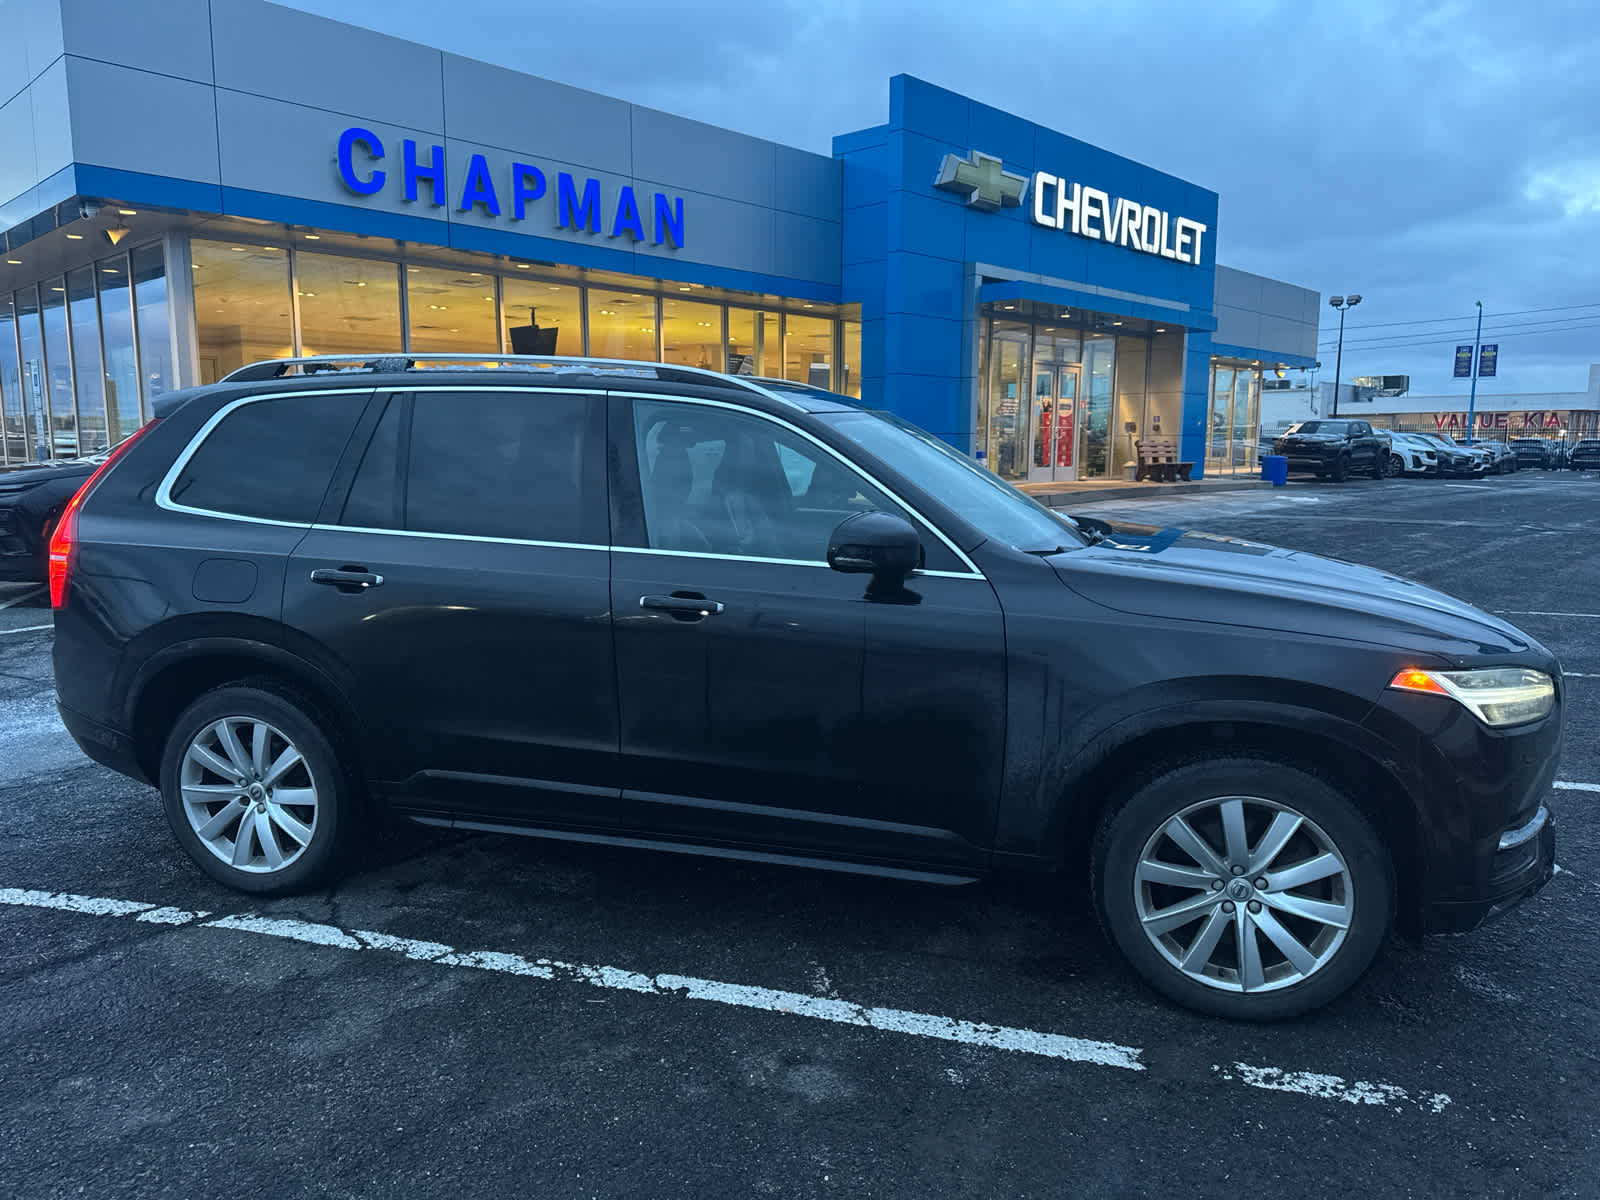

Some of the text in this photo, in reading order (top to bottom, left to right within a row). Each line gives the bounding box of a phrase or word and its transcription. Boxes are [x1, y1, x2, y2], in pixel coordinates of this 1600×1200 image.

[337, 127, 685, 249] CHAPMAN
[1034, 171, 1207, 265] CHEVROLET
[1434, 411, 1561, 429] VALUE KIA
